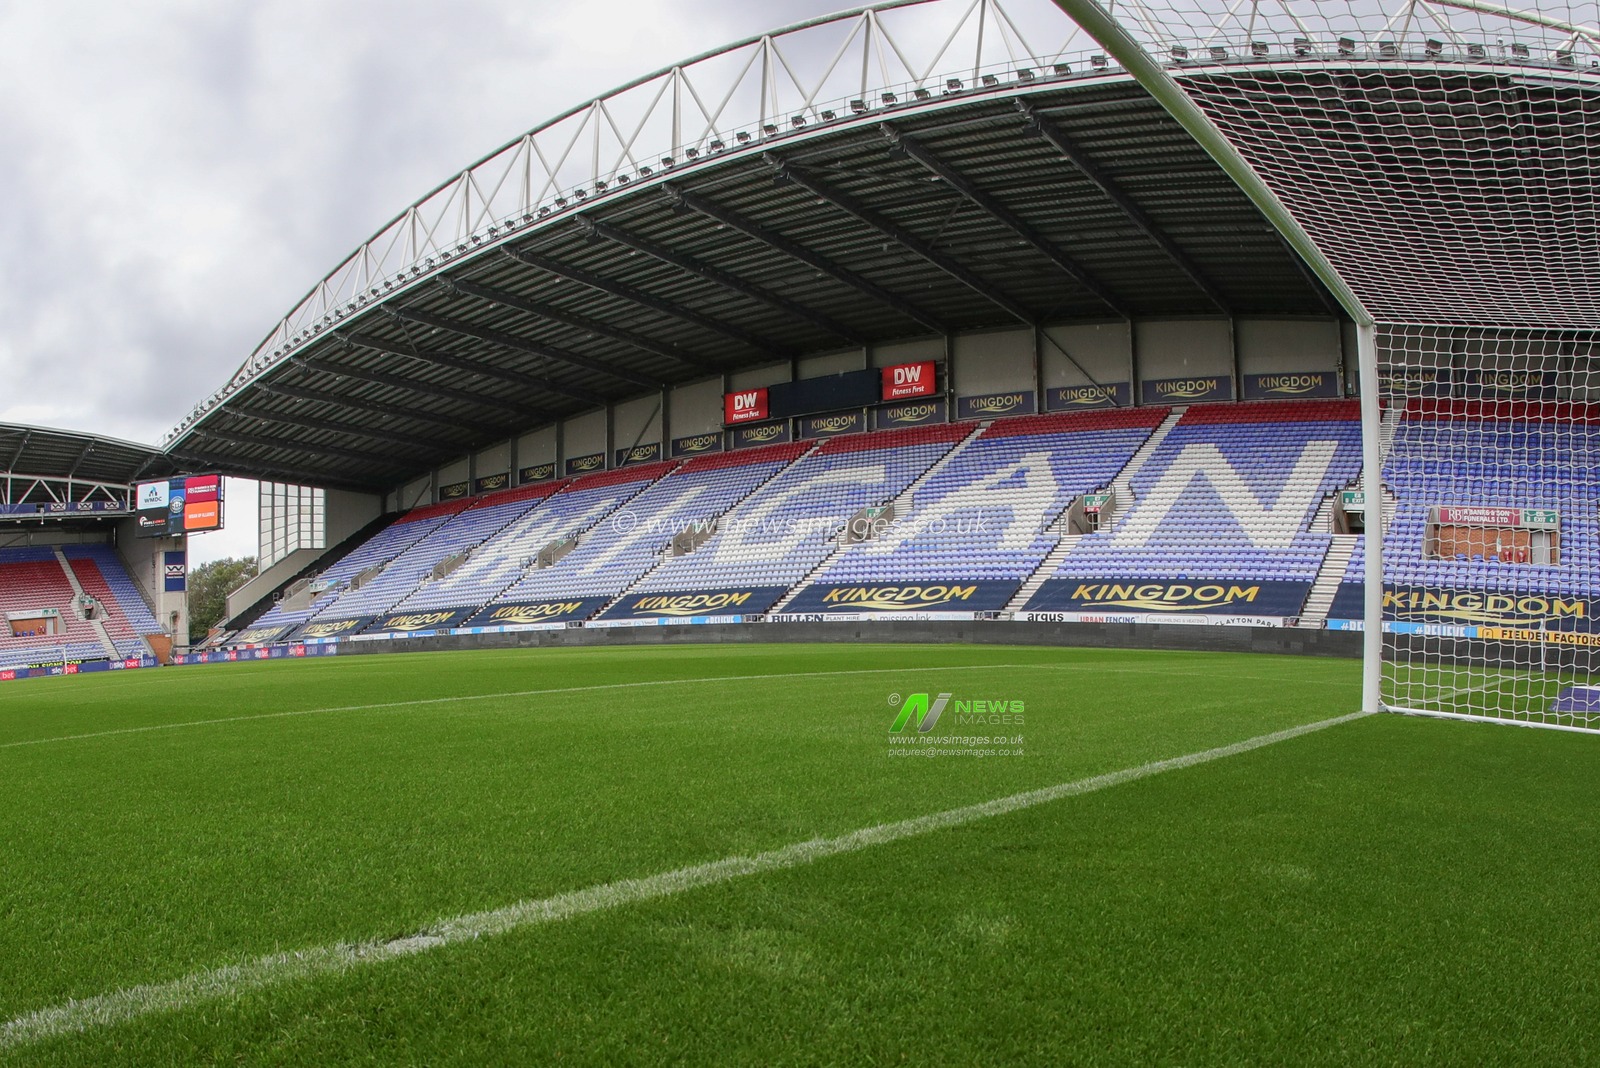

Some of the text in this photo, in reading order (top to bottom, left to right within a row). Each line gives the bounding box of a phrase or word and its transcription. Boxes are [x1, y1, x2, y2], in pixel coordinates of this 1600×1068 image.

[894, 366, 922, 385] DW
[1258, 375, 1323, 389] KINGDOM
[892, 385, 925, 396] Fitness First
[1059, 386, 1117, 400] KINGDOM
[1155, 379, 1217, 394] KINGDOM
[734, 392, 758, 411] DW
[969, 394, 1024, 409] KINGDOM
[732, 409, 760, 421] Fitness First
[886, 404, 937, 419] KINGDOM
[811, 415, 857, 430] KINGDOM
[742, 424, 784, 440] KINGDOM
[679, 435, 718, 449] KINGDOM
[571, 455, 603, 468] KINGDOM
[524, 464, 554, 477] KINGDOM
[480, 475, 506, 487] KINGDOM
[144, 496, 163, 504] WMDC
[1447, 509, 1463, 521] RB
[1463, 515, 1495, 523] FUNERALS
[1469, 508, 1490, 516] BANKS
[631, 591, 753, 609] KINGDOM
[822, 585, 978, 603] KINGDOM
[1070, 584, 1261, 602] KINGDOM
[489, 601, 584, 618] KINGDOM
[1382, 590, 1584, 619] KINGDOM
[383, 611, 457, 627] KINGDOM
[771, 613, 825, 623] BULLEN
[879, 613, 931, 621] missing link
[1027, 612, 1064, 622] argus
[1080, 615, 1136, 624] URBAN FENCING
[302, 619, 360, 634] KINGDOM
[1501, 629, 1600, 645] FIELDEN FACTORS
[51, 666, 64, 674] sky
[126, 660, 139, 668] bet
[2, 670, 14, 679] bet
